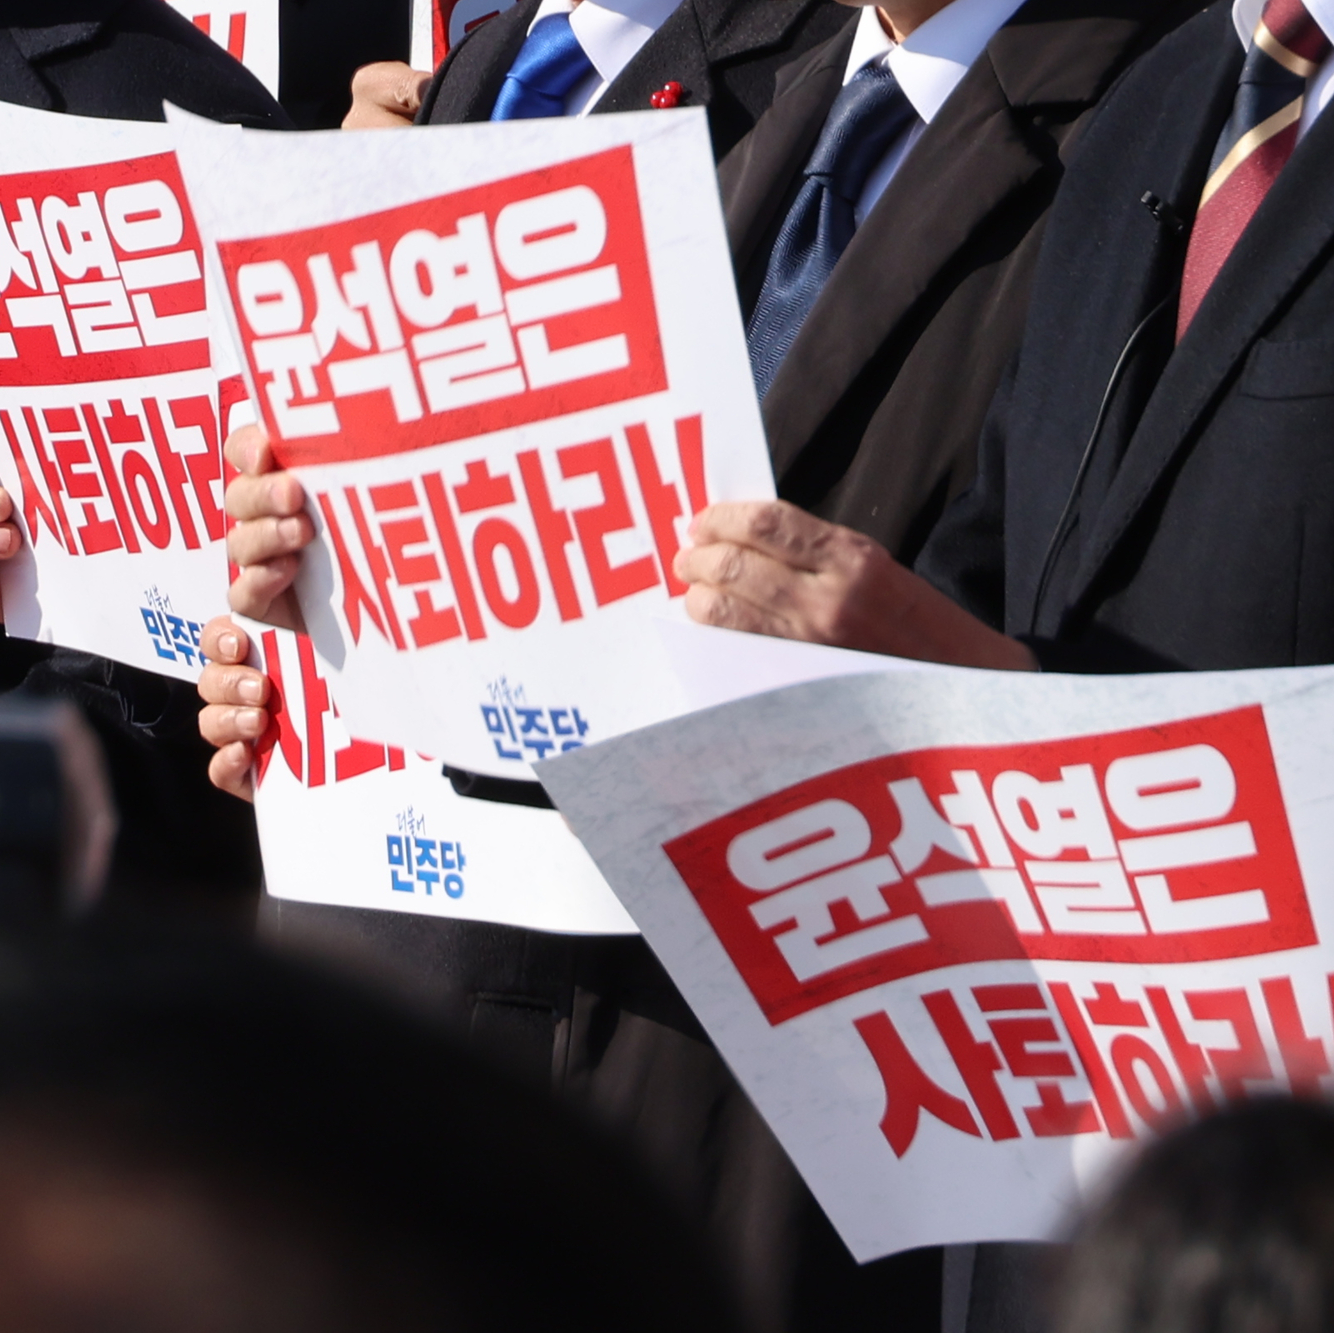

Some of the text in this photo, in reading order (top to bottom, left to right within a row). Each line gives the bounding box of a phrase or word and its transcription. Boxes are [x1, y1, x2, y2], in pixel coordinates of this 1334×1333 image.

[237, 185, 630, 440] 윤석열은
[317, 412, 708, 652] 사퇴하라!
[479, 704, 589, 764] 민주당
[386, 834, 467, 900] 민주당
[726, 743, 1270, 984] 윤석열은
